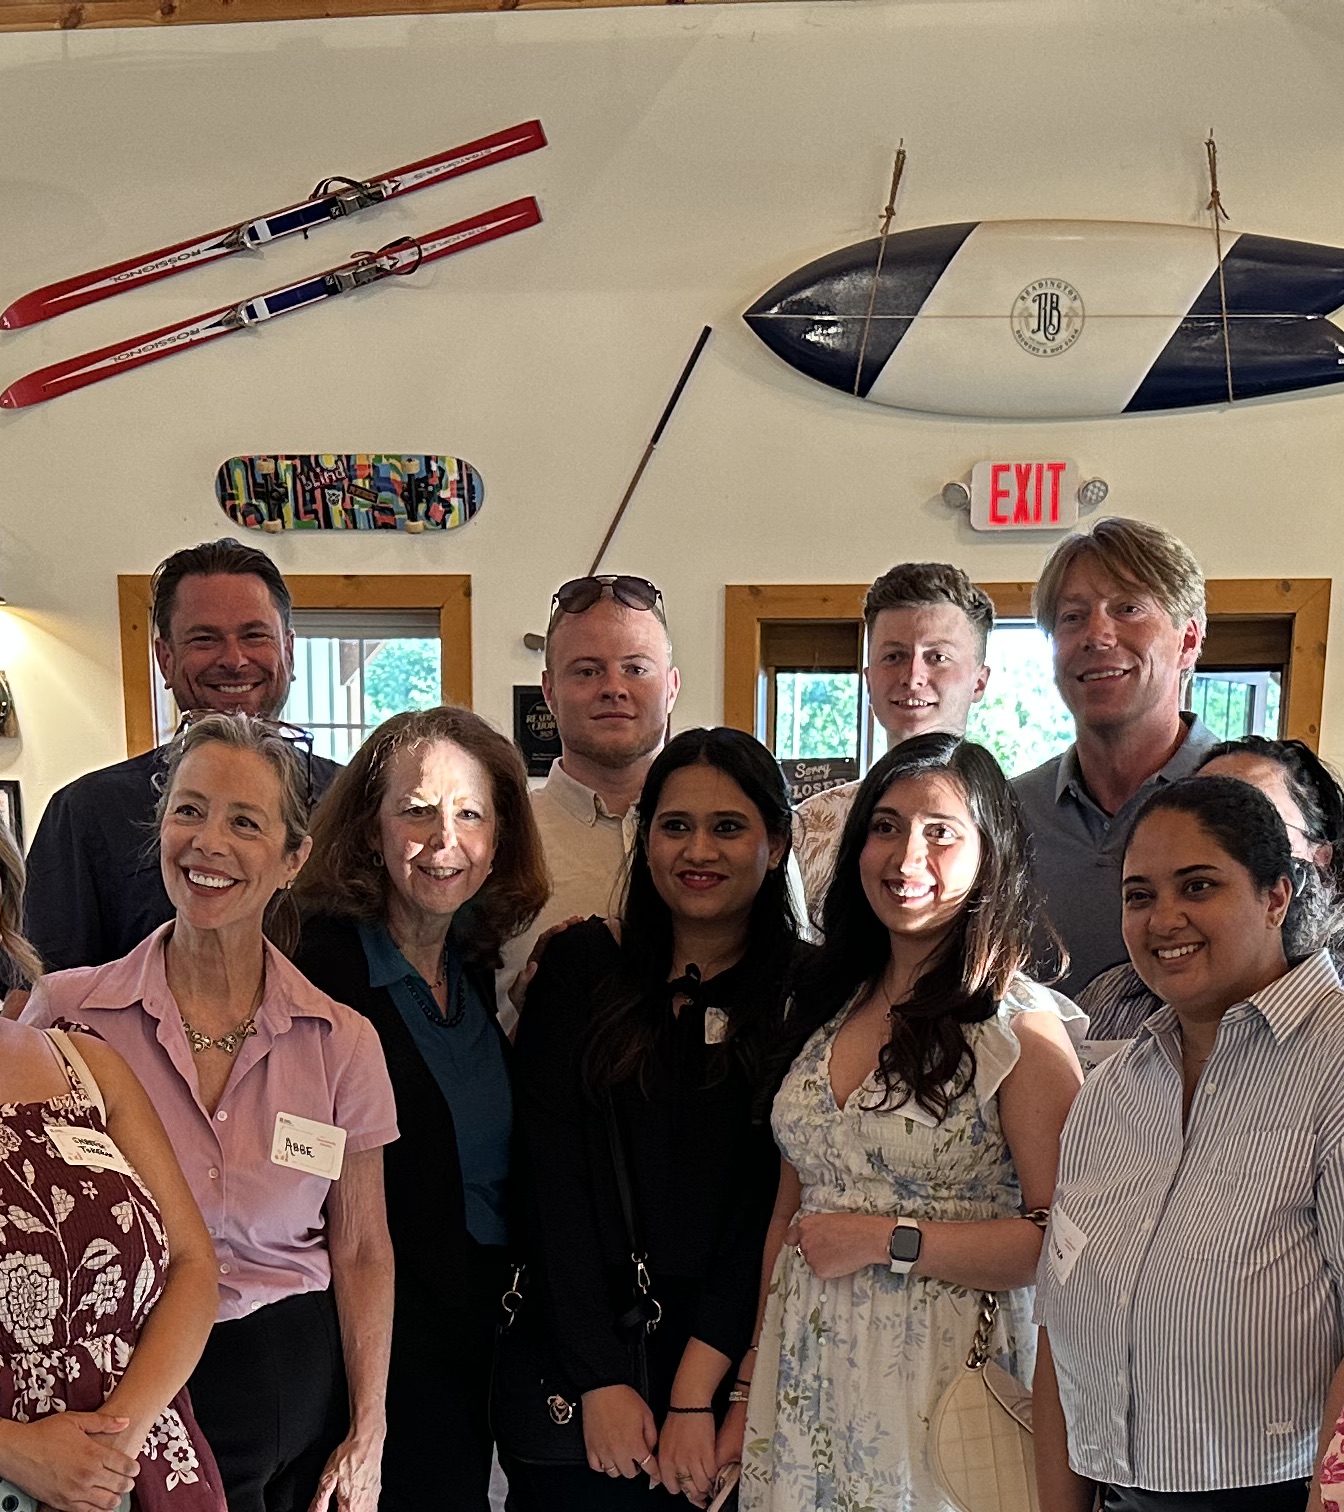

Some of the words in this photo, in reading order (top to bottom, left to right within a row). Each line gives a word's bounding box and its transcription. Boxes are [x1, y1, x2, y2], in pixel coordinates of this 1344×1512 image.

[110, 249, 201, 282] ROSSIGNOL
[1019, 280, 1078, 301] READINGTON
[111, 328, 200, 362] ROSSIGNOL
[988, 463, 1066, 525] EXIT
[794, 763, 832, 779] Sorry
[285, 1137, 316, 1159] ABBE
